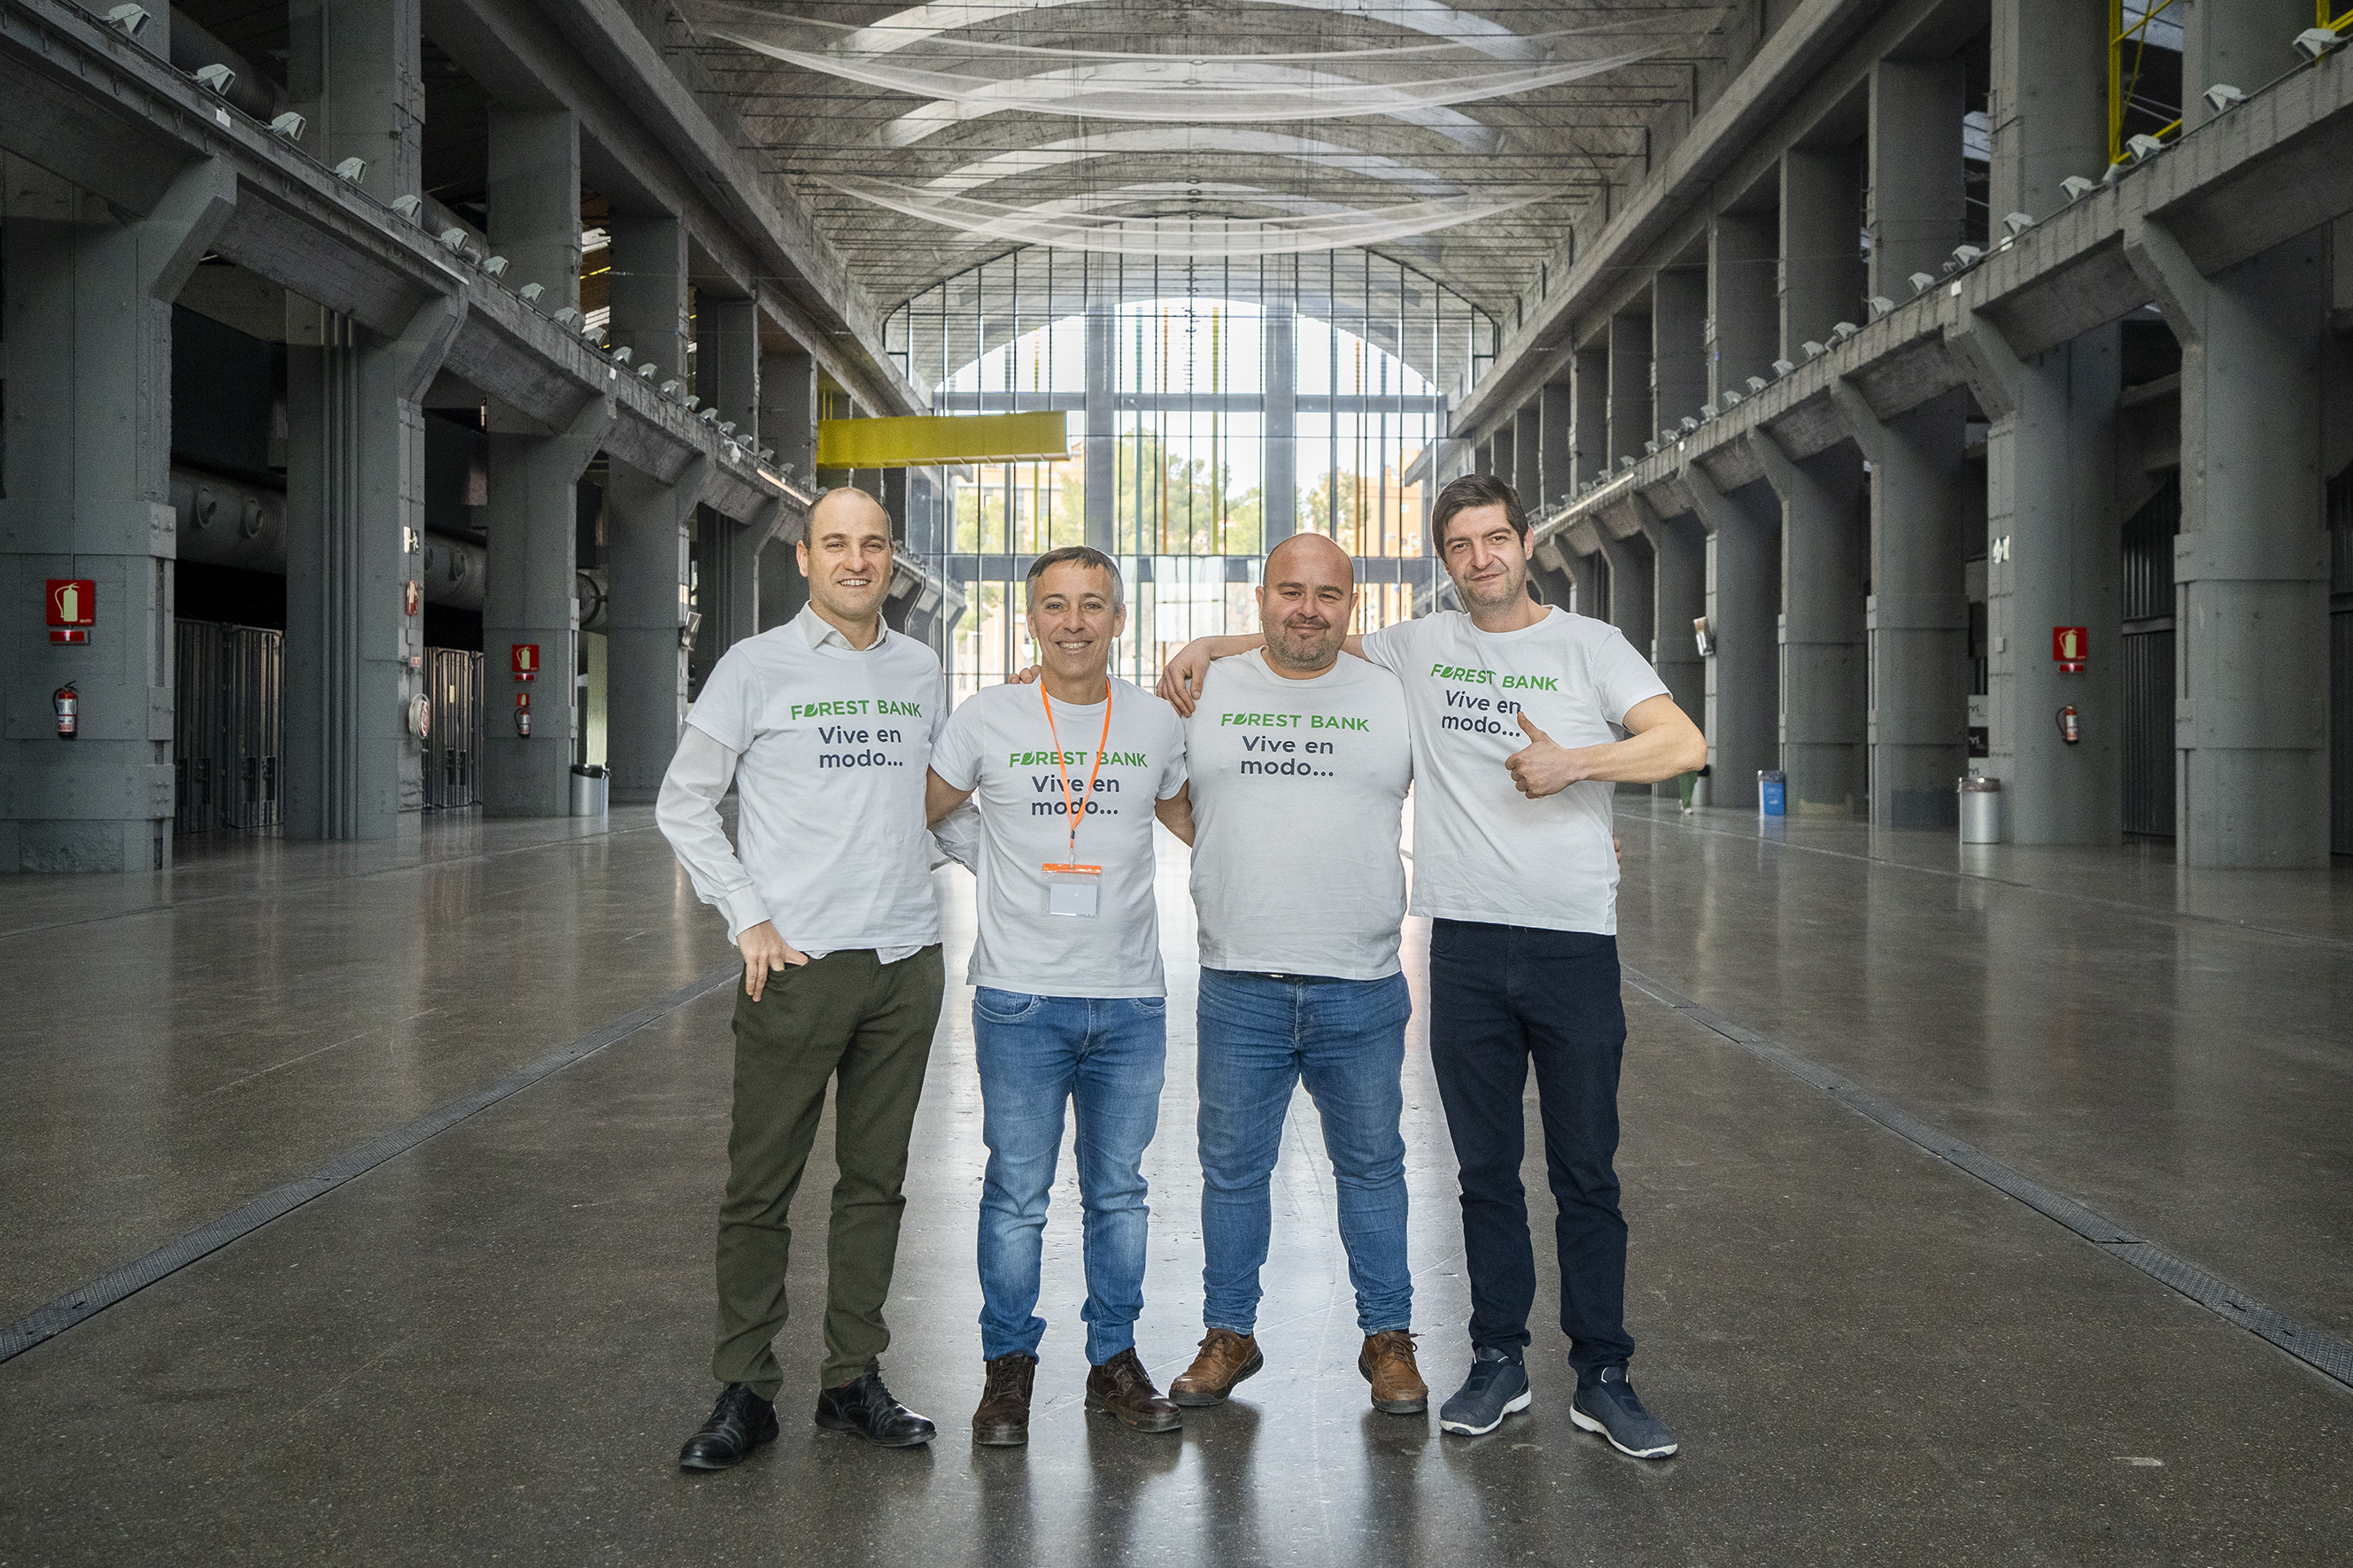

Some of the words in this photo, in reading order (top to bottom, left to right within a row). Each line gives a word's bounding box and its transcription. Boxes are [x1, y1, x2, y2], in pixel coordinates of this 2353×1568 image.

[1501, 675, 1560, 691] BANK
[877, 699, 923, 718] BANK
[1445, 689, 1490, 711] Vive
[1497, 699, 1521, 714] en
[1311, 714, 1370, 732] BANK
[1441, 714, 1521, 738] modo...
[817, 725, 870, 745] Vive
[876, 729, 902, 743] en
[1242, 735, 1296, 753] Vive
[1304, 741, 1334, 755] en
[819, 748, 903, 769] modo...
[1096, 751, 1149, 768] BANK
[1240, 758, 1335, 777] modo...
[1092, 778, 1119, 792] en
[1031, 797, 1118, 816] modo...
